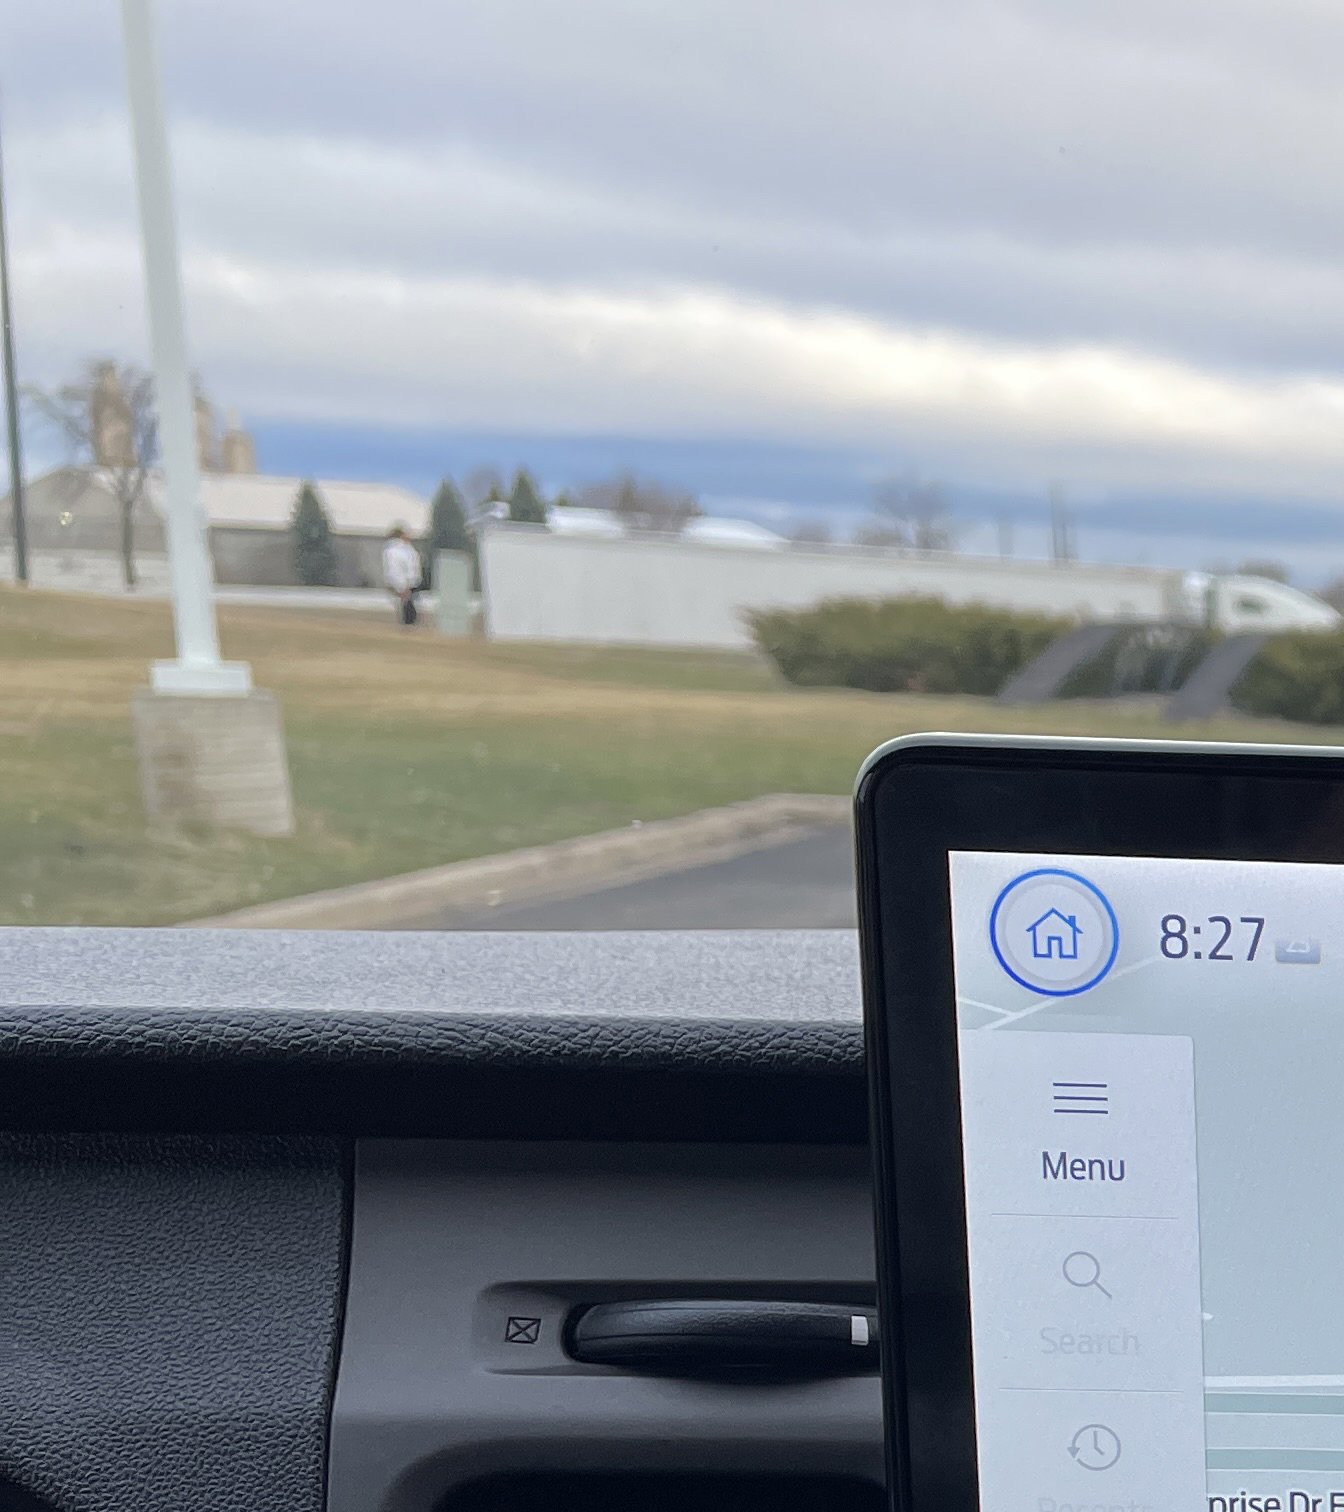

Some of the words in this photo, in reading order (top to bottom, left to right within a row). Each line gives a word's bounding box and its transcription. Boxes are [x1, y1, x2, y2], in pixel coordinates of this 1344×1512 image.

[1159, 914, 1267, 962] 8:27
[1040, 1150, 1127, 1182] Menu
[1039, 1326, 1141, 1356] Search
